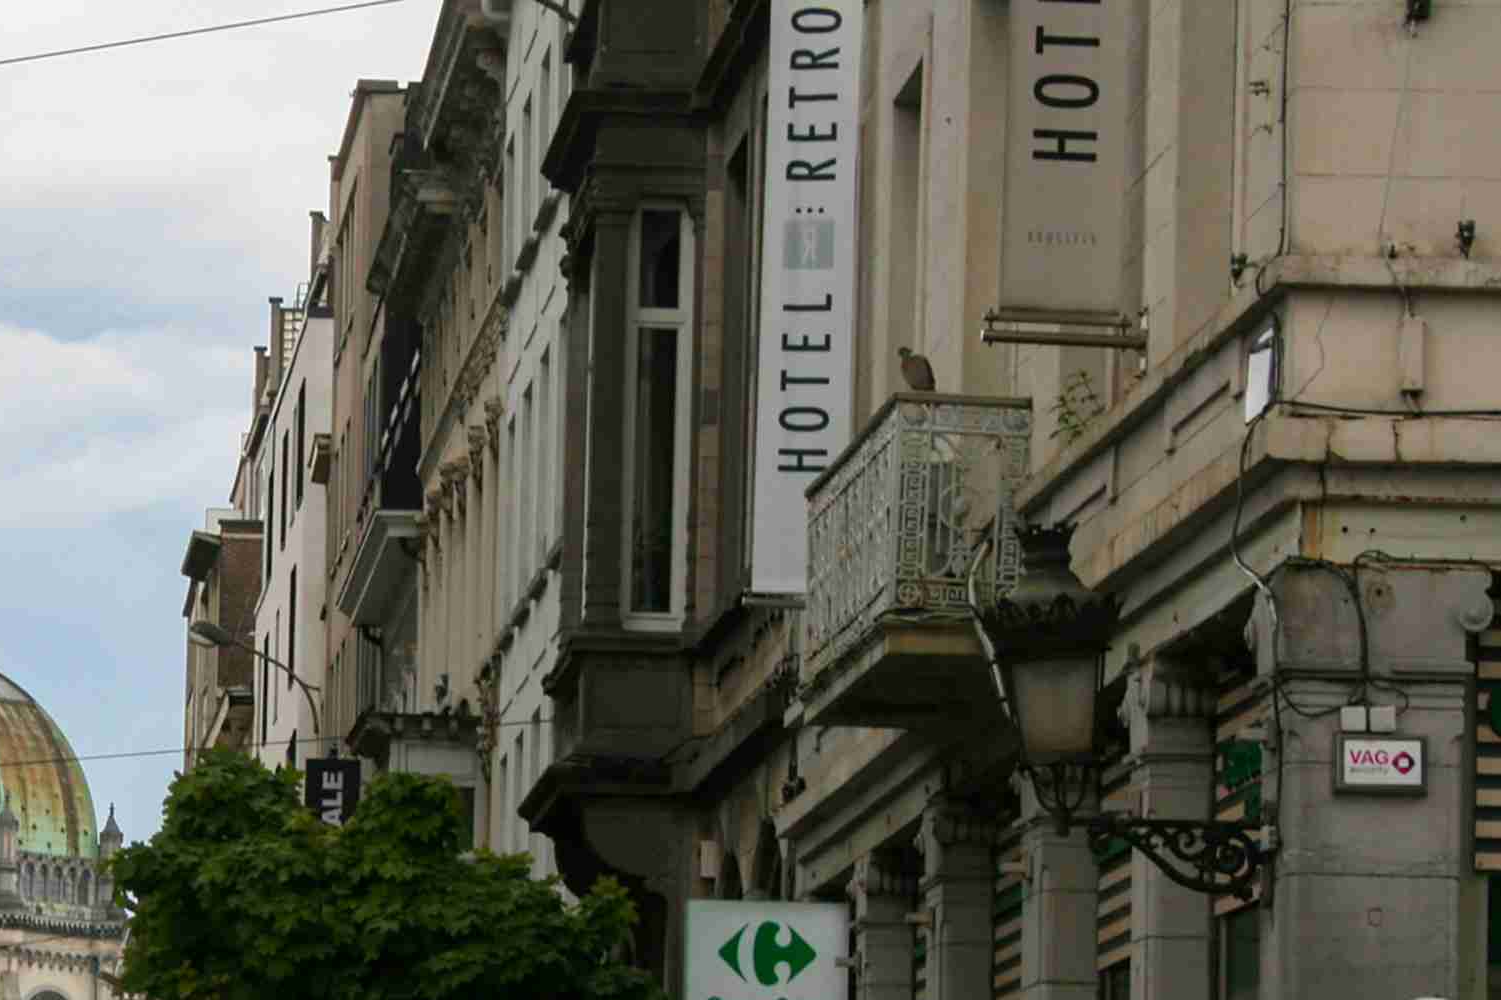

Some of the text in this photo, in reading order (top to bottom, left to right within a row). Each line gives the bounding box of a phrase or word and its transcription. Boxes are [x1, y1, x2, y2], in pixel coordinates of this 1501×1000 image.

[1033, 0, 1100, 162] HOT
[777, 7, 842, 473] HOTEL RETRO
[1349, 750, 1389, 765] VAG
